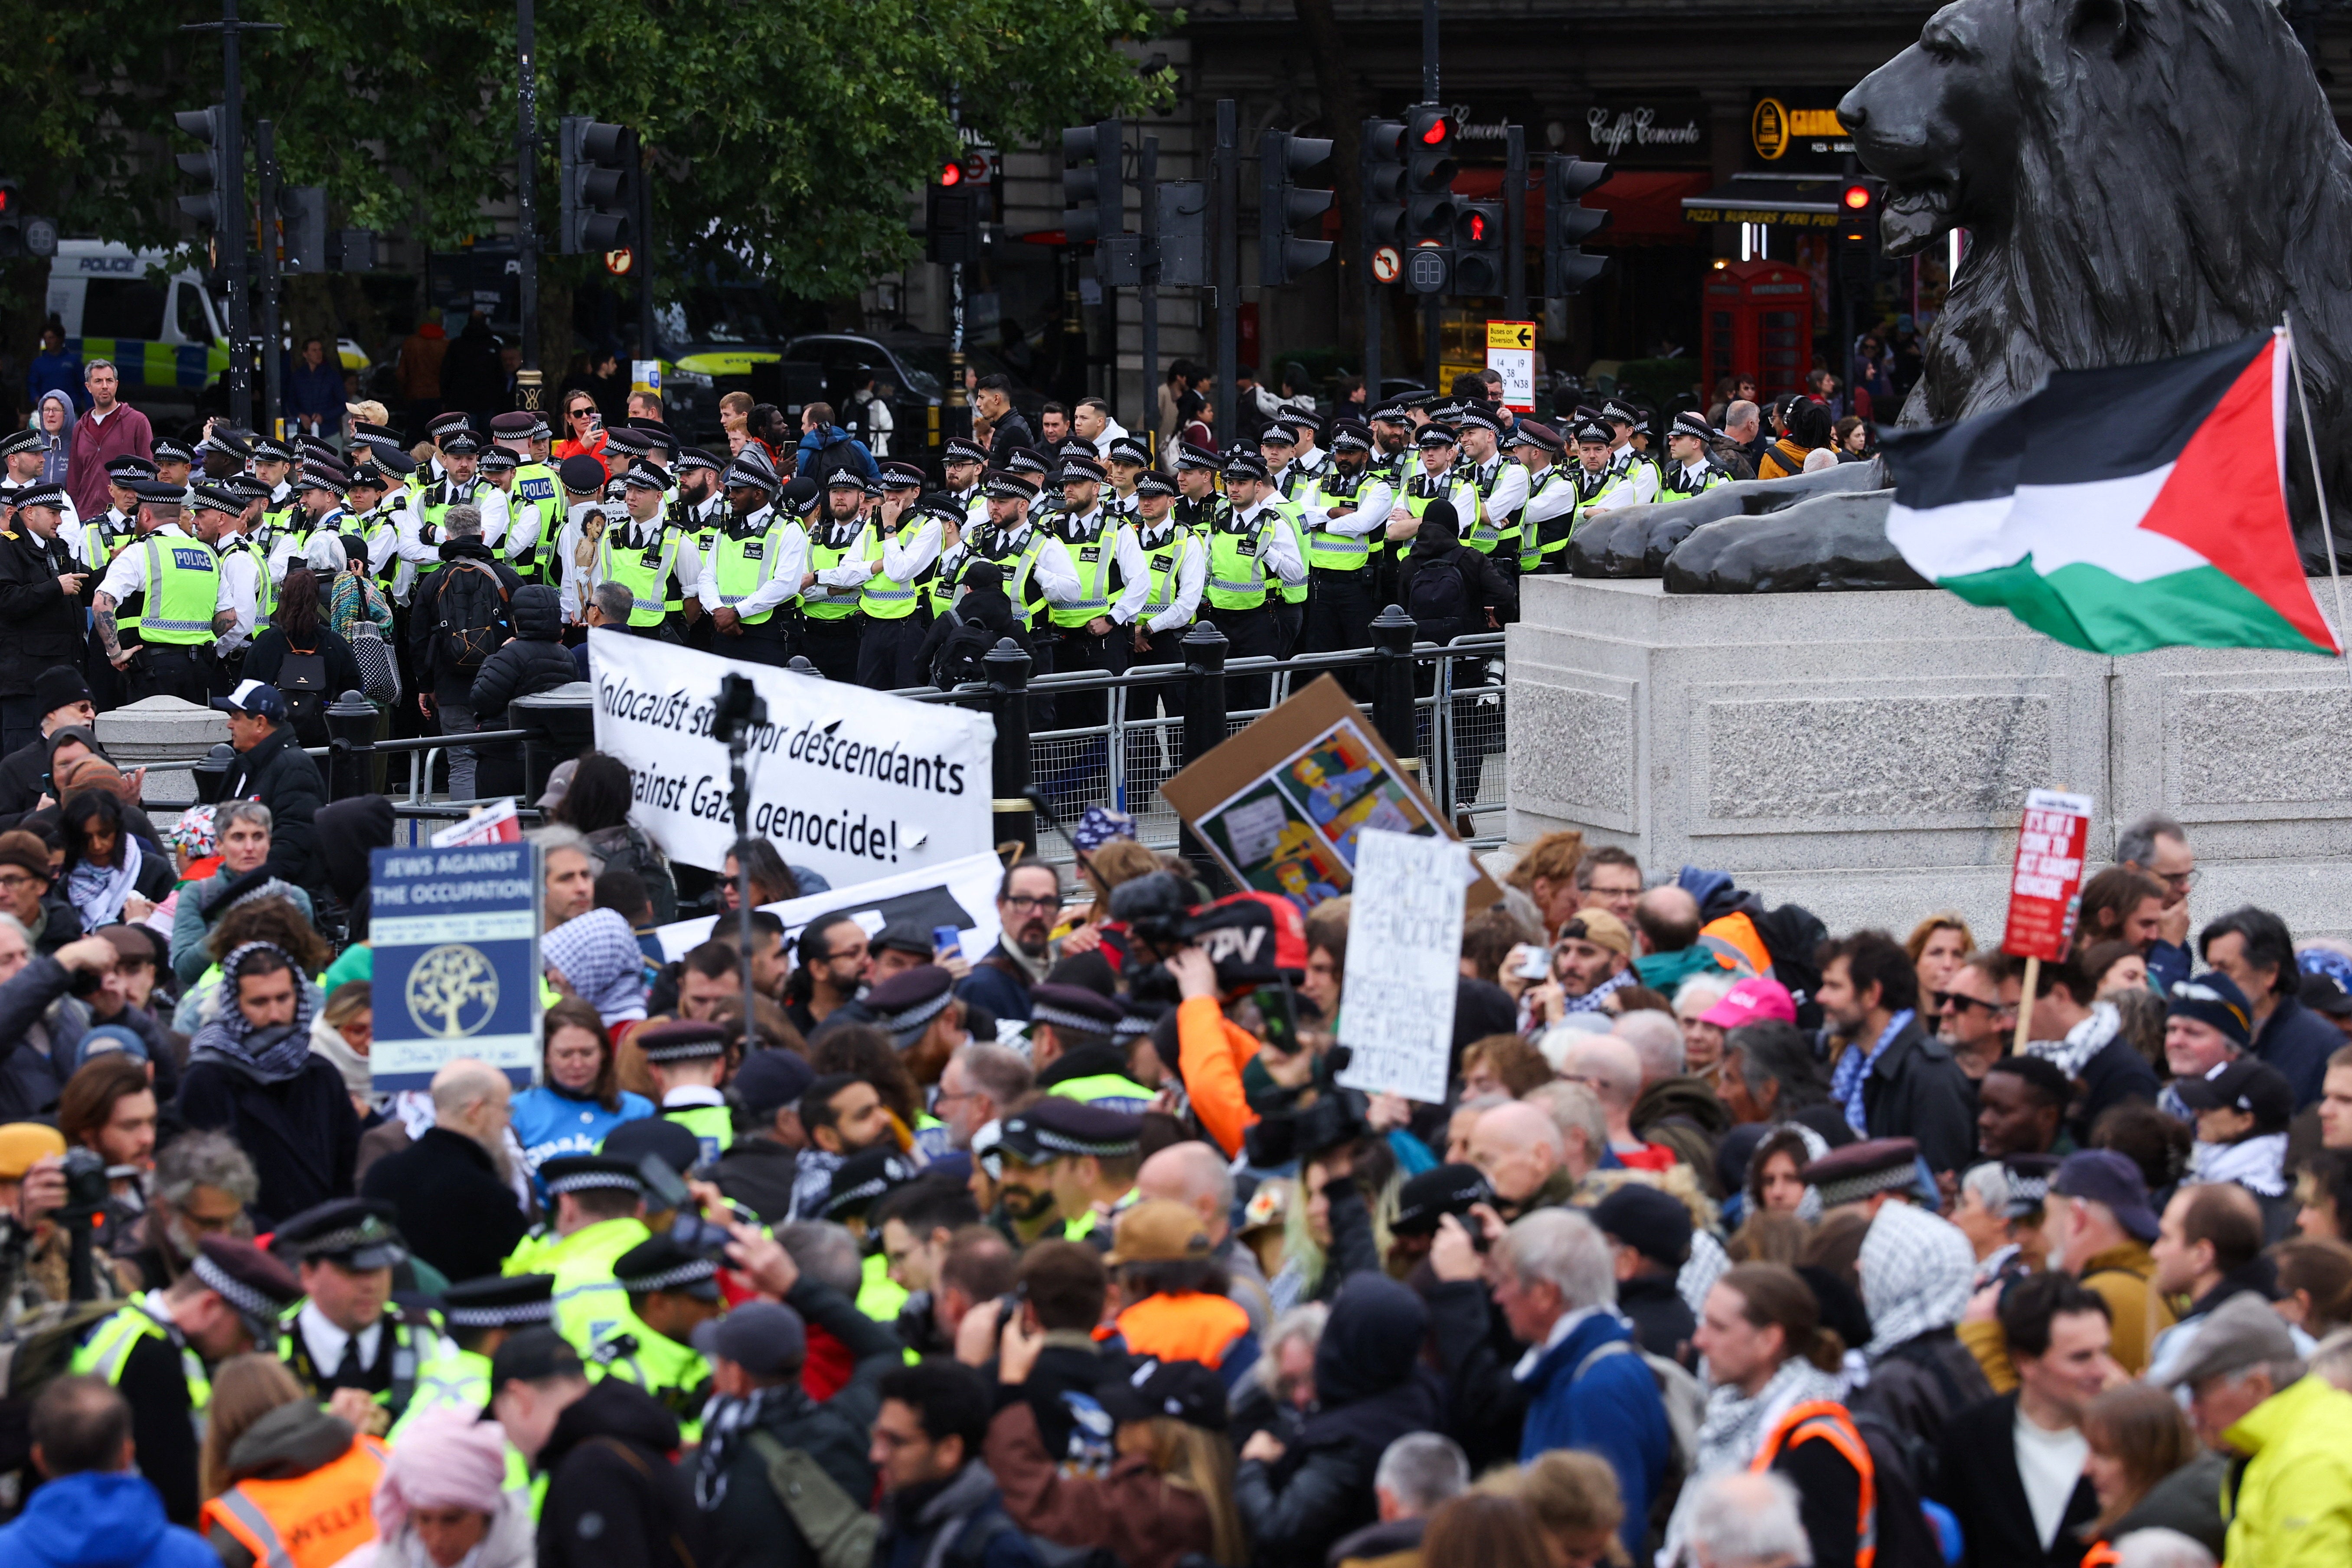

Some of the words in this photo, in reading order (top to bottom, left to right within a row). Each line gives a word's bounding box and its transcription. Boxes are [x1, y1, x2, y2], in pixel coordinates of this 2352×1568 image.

[1633, 106, 1700, 147] Concerto
[1686, 208, 1719, 222] PIZZA
[1725, 210, 1779, 224] BURGERS
[1782, 212, 1810, 226] PERI
[80, 258, 136, 272] POLICE
[1497, 359, 1504, 367] 14
[1518, 359, 1525, 368] 19
[1506, 369, 1515, 378] 38
[522, 481, 554, 497] POLICE
[175, 551, 212, 568] POLICE
[790, 720, 964, 795] descendants
[691, 775, 736, 824] Gaz
[756, 802, 897, 863] genocide!
[383, 855, 433, 879] JEWS
[435, 850, 520, 875] AGAINST
[372, 884, 408, 906] THE
[410, 879, 533, 905] OCCUPATION
